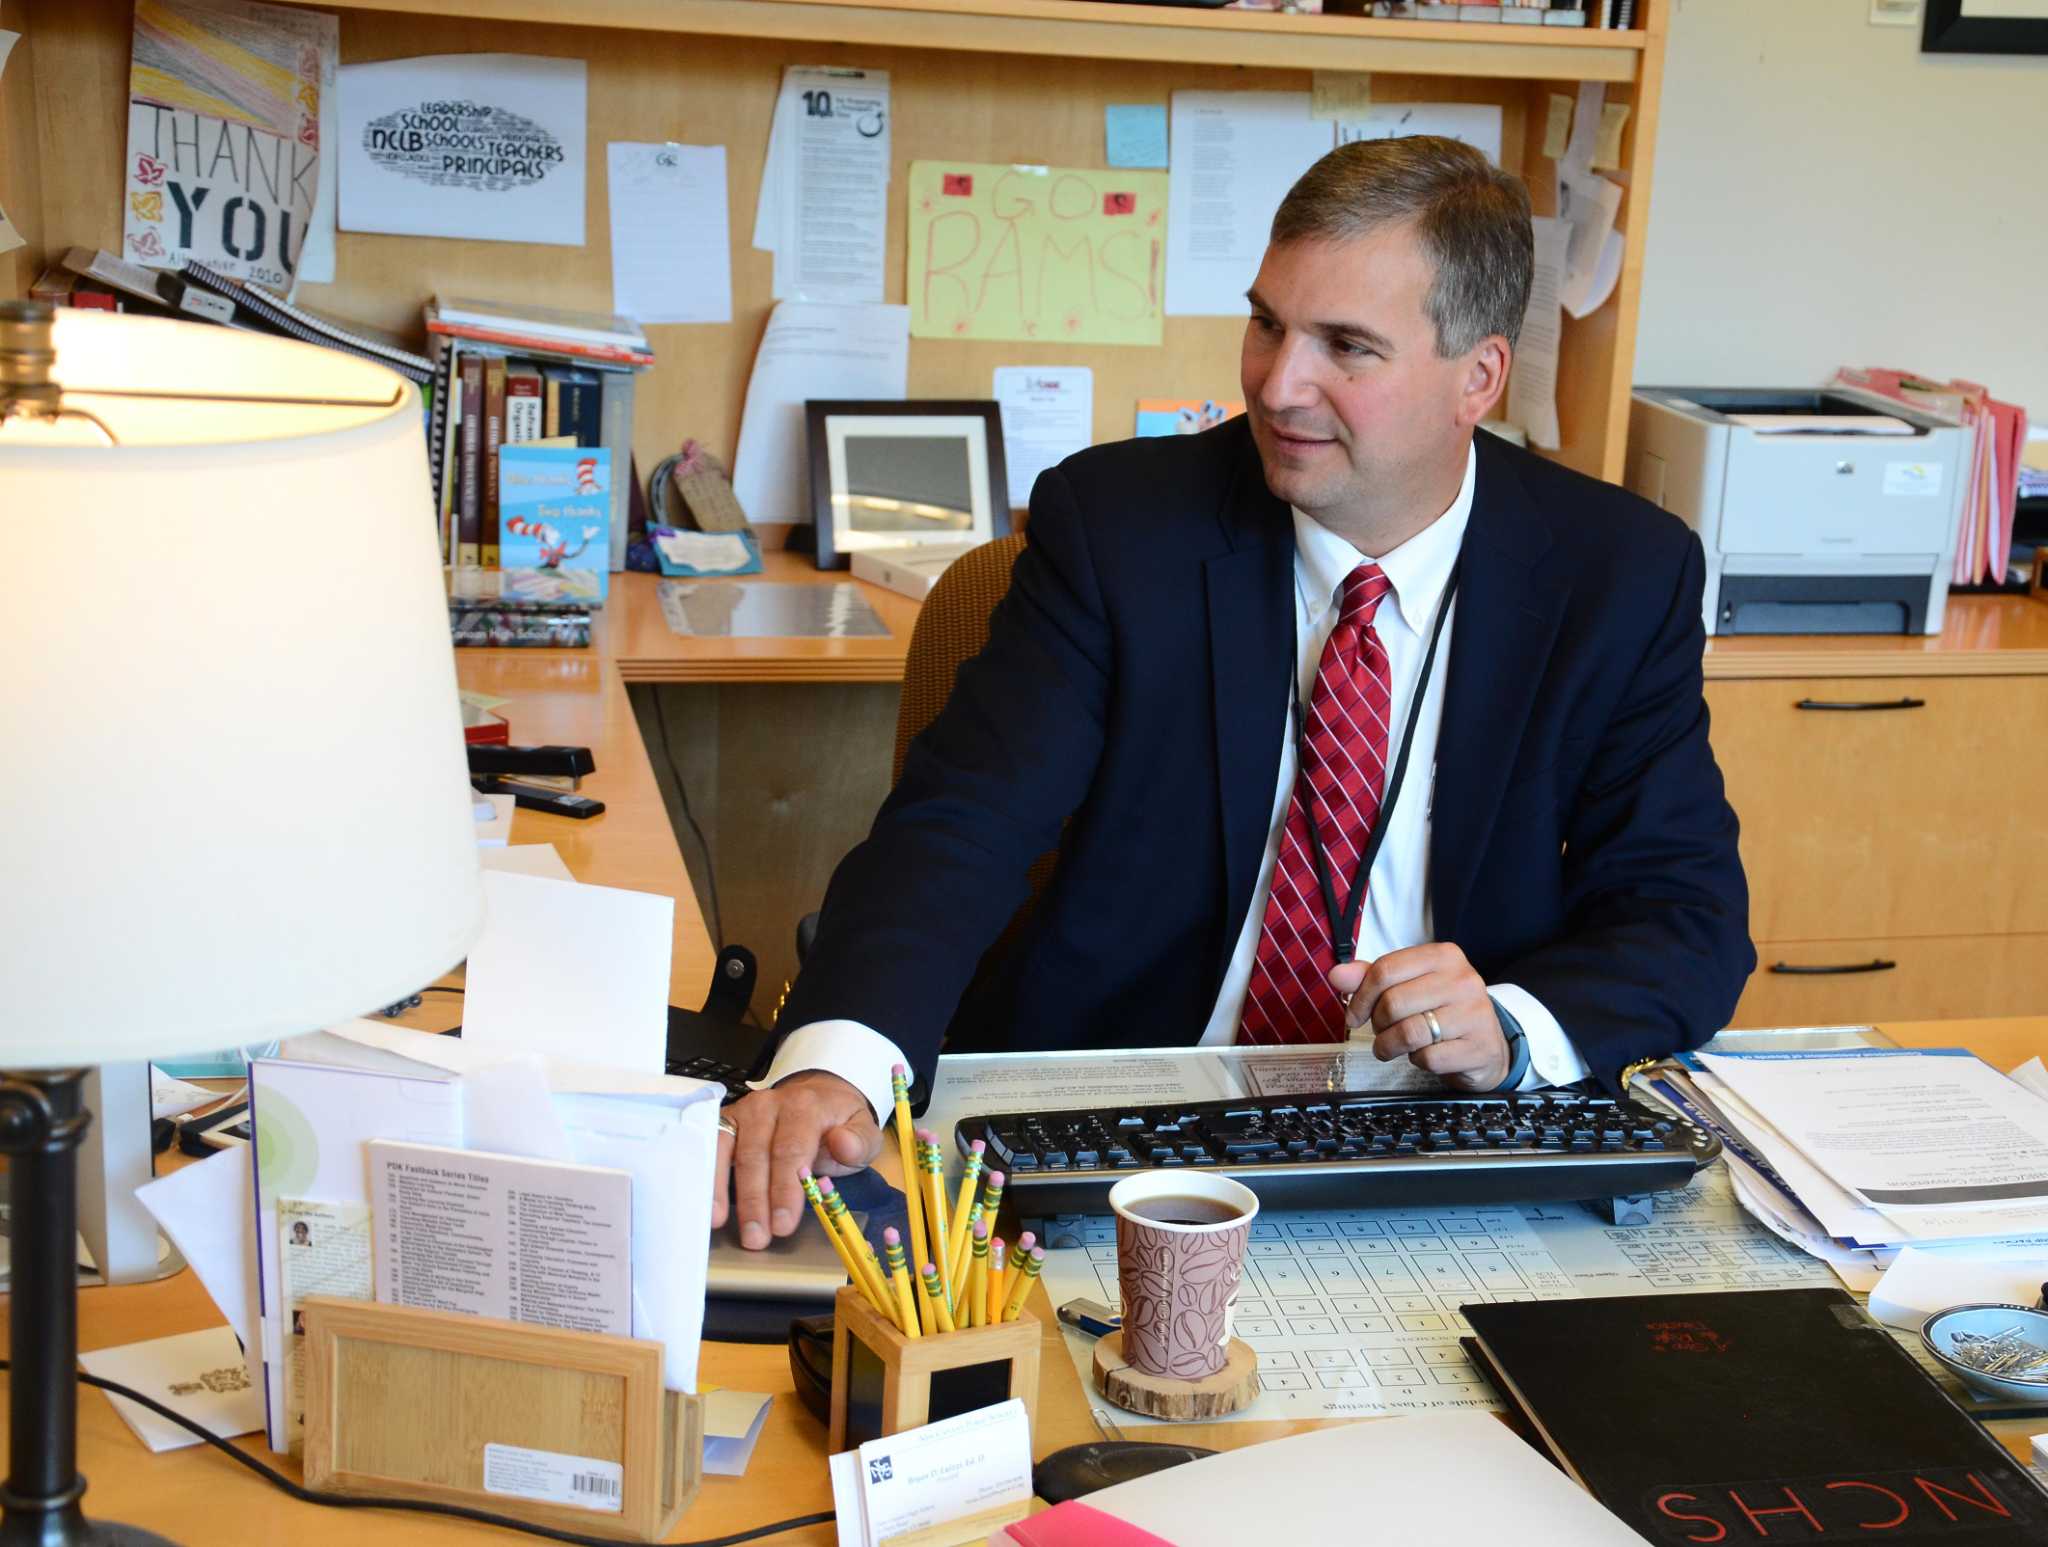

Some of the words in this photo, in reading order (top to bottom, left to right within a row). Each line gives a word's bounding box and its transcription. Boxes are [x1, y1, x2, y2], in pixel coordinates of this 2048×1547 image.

[421, 101, 492, 118] LEADERSHIP
[802, 90, 832, 117] 10
[401, 112, 460, 133] SCHOOL
[371, 128, 424, 152] NCLB
[424, 131, 486, 151] SCHOOLS
[131, 99, 318, 213] THANK
[488, 141, 564, 163] TEACHERS
[442, 154, 545, 180] PRINCIPALS
[992, 168, 1098, 220] GO
[441, 1168, 466, 1180] Series
[468, 1172, 489, 1184] Titles
[1321, 1402, 1387, 1412] Meetings
[1390, 1400, 1427, 1409] Class
[1431, 1400, 1444, 1408] of
[1657, 1472, 2011, 1543] NCHS
